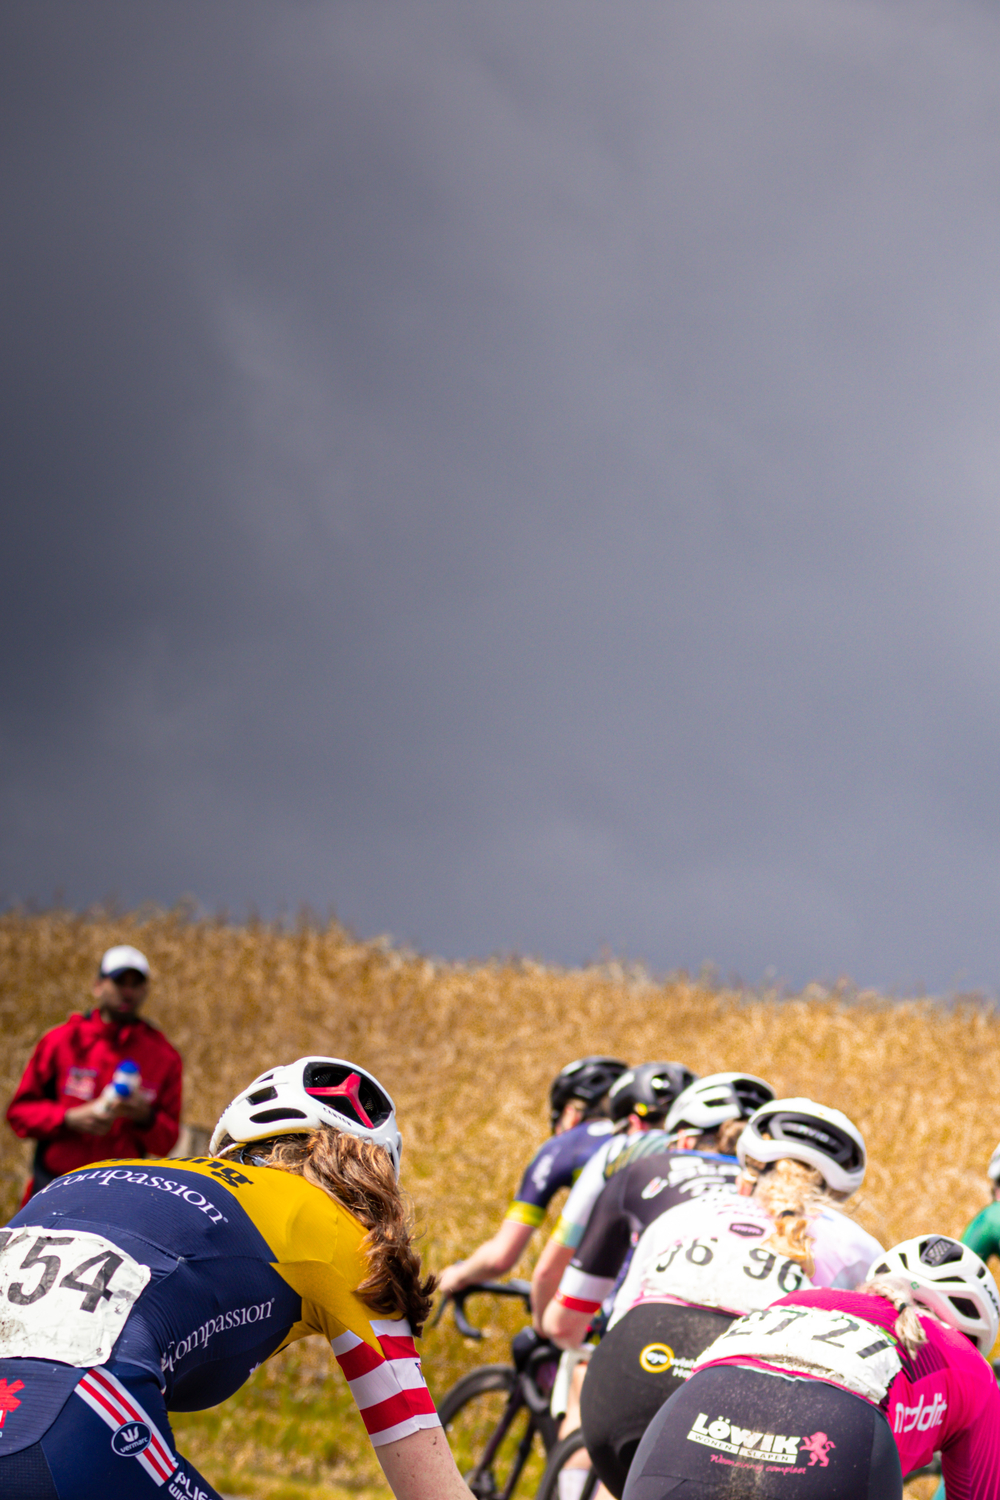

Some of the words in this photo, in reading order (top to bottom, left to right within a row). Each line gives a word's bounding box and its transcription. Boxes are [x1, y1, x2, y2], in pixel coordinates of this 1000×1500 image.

[120, 1436, 149, 1453] vermarc
[691, 1412, 801, 1455] LÖWIK
[694, 1434, 733, 1451] WONEN
[746, 1451, 789, 1462] SLAPEN
